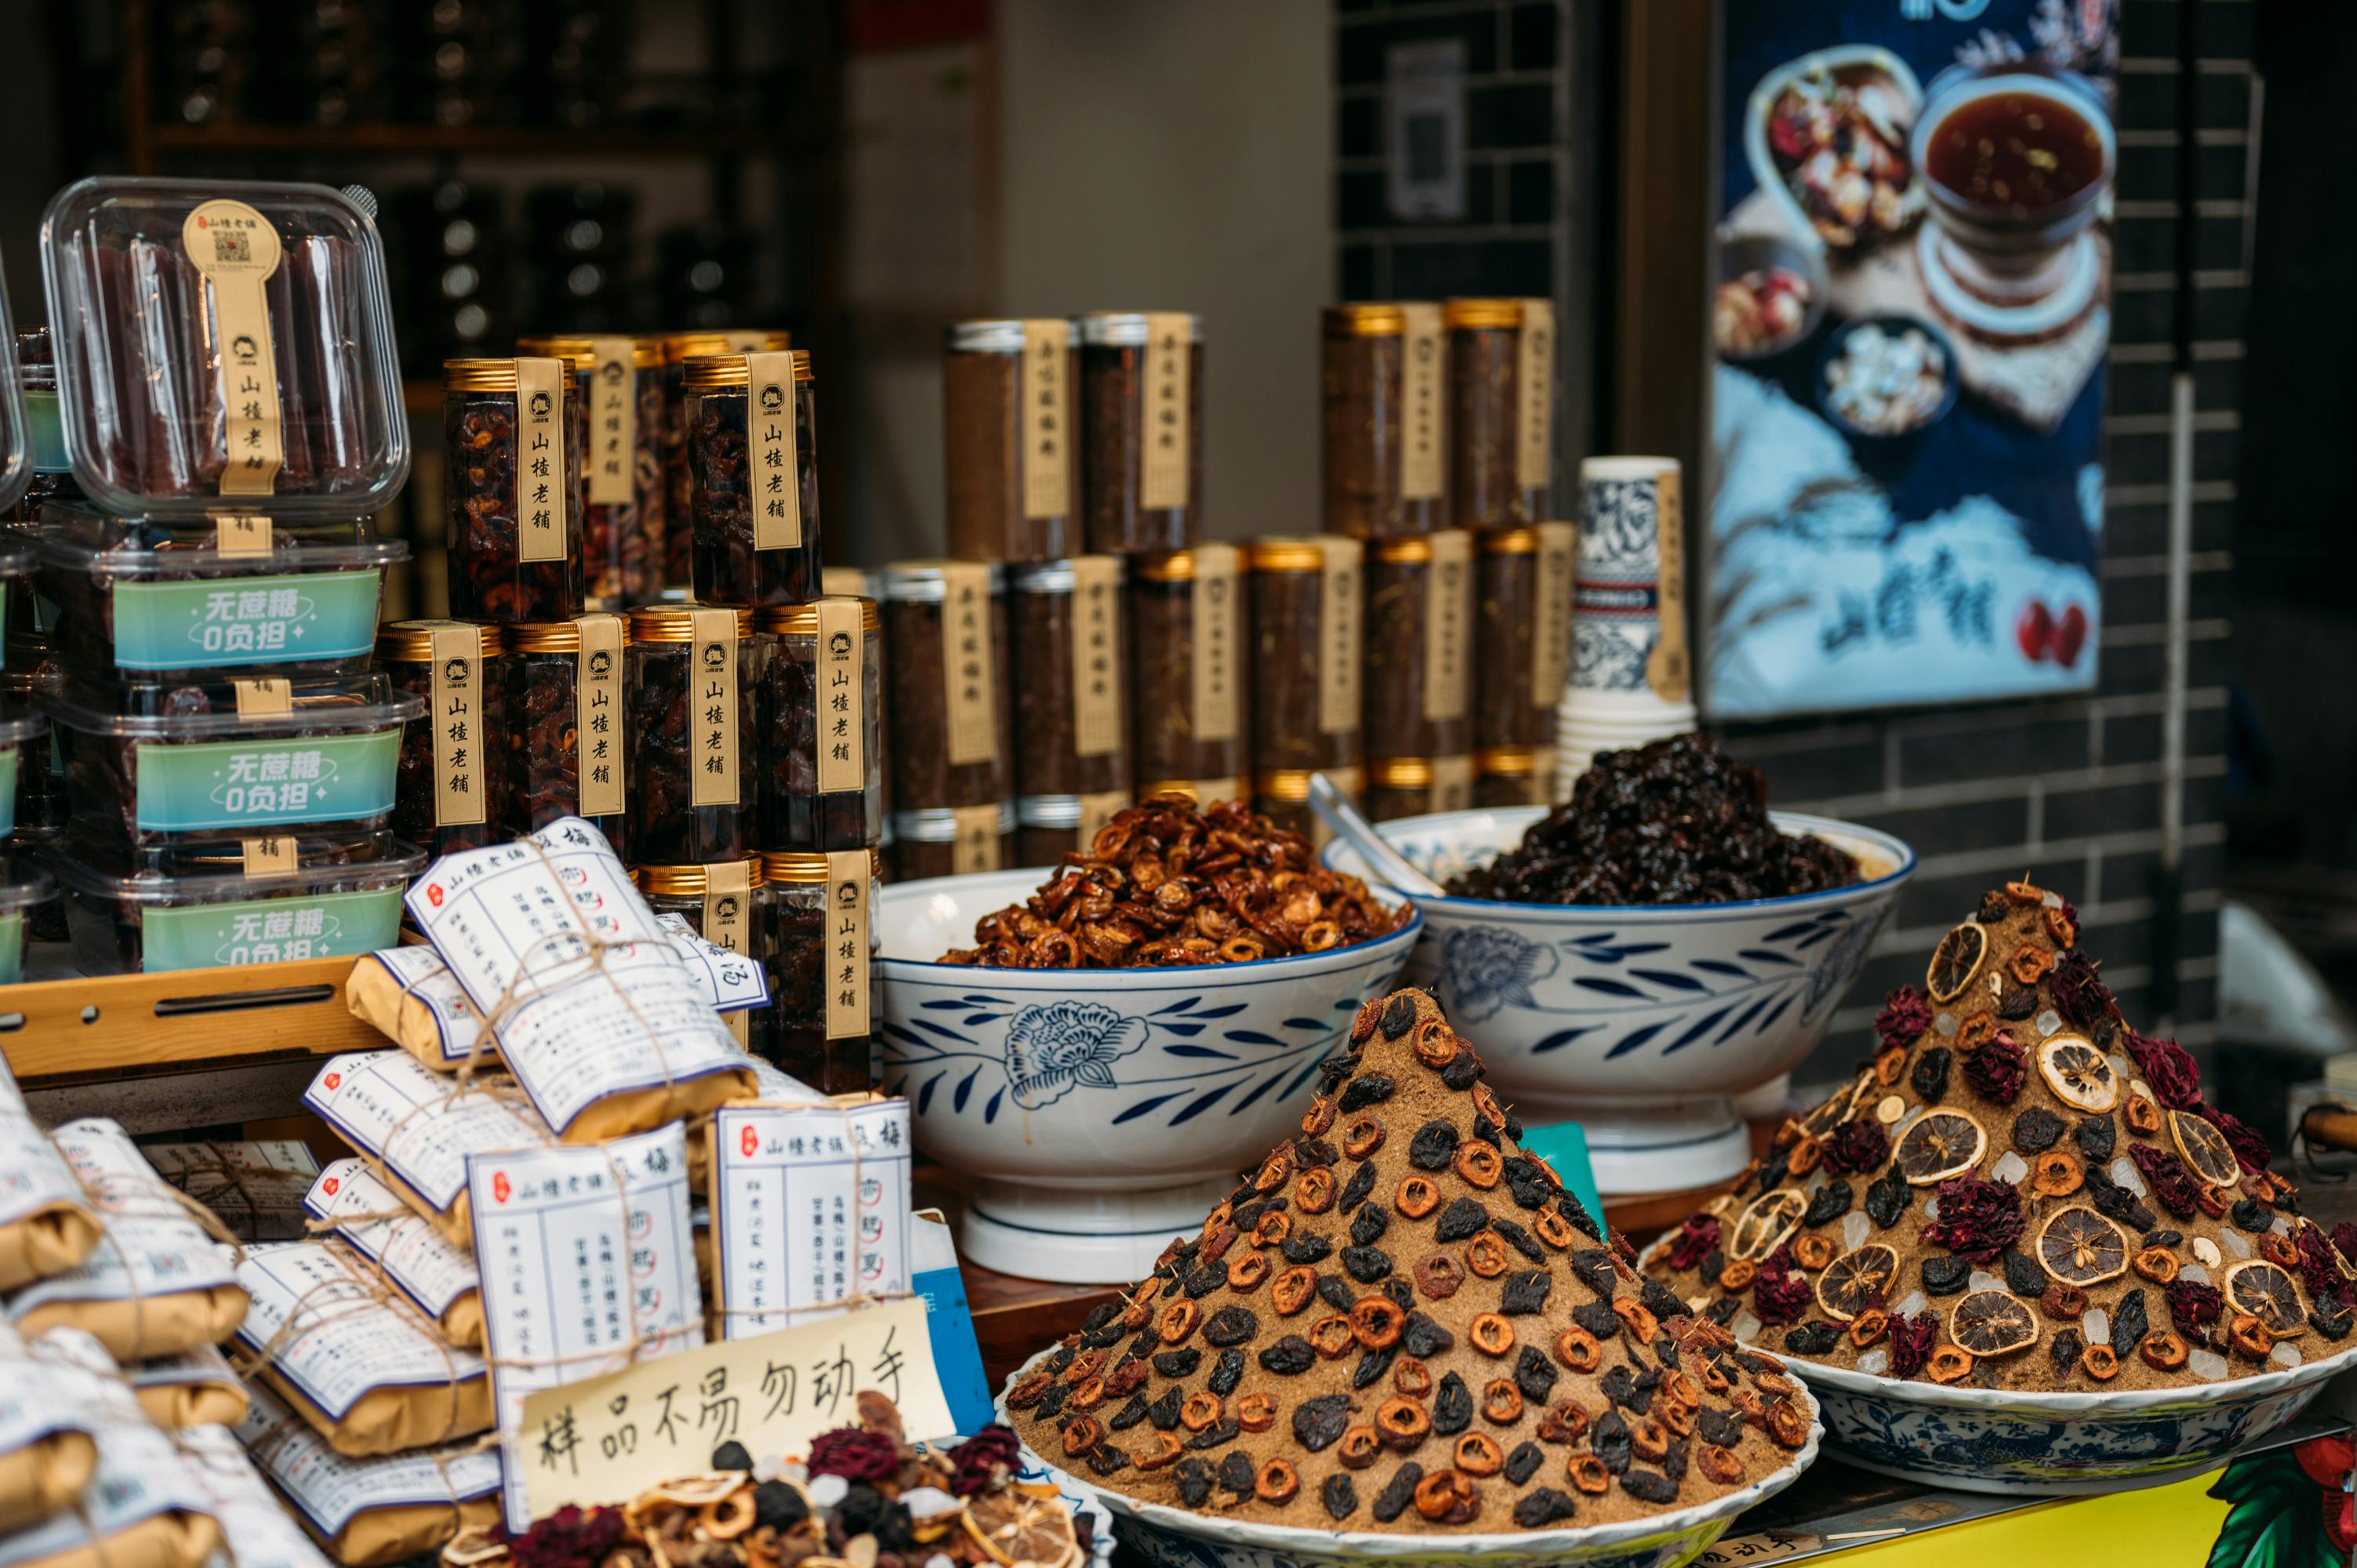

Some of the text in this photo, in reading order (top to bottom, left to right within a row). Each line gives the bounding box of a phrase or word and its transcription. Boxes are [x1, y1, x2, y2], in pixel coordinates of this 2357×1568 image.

[205, 589, 299, 621] 无蔗糖
[203, 621, 286, 652] 0负担
[227, 750, 321, 783] 无蔗糖
[226, 782, 310, 813] 0负担
[232, 908, 325, 942] 无蔗糖
